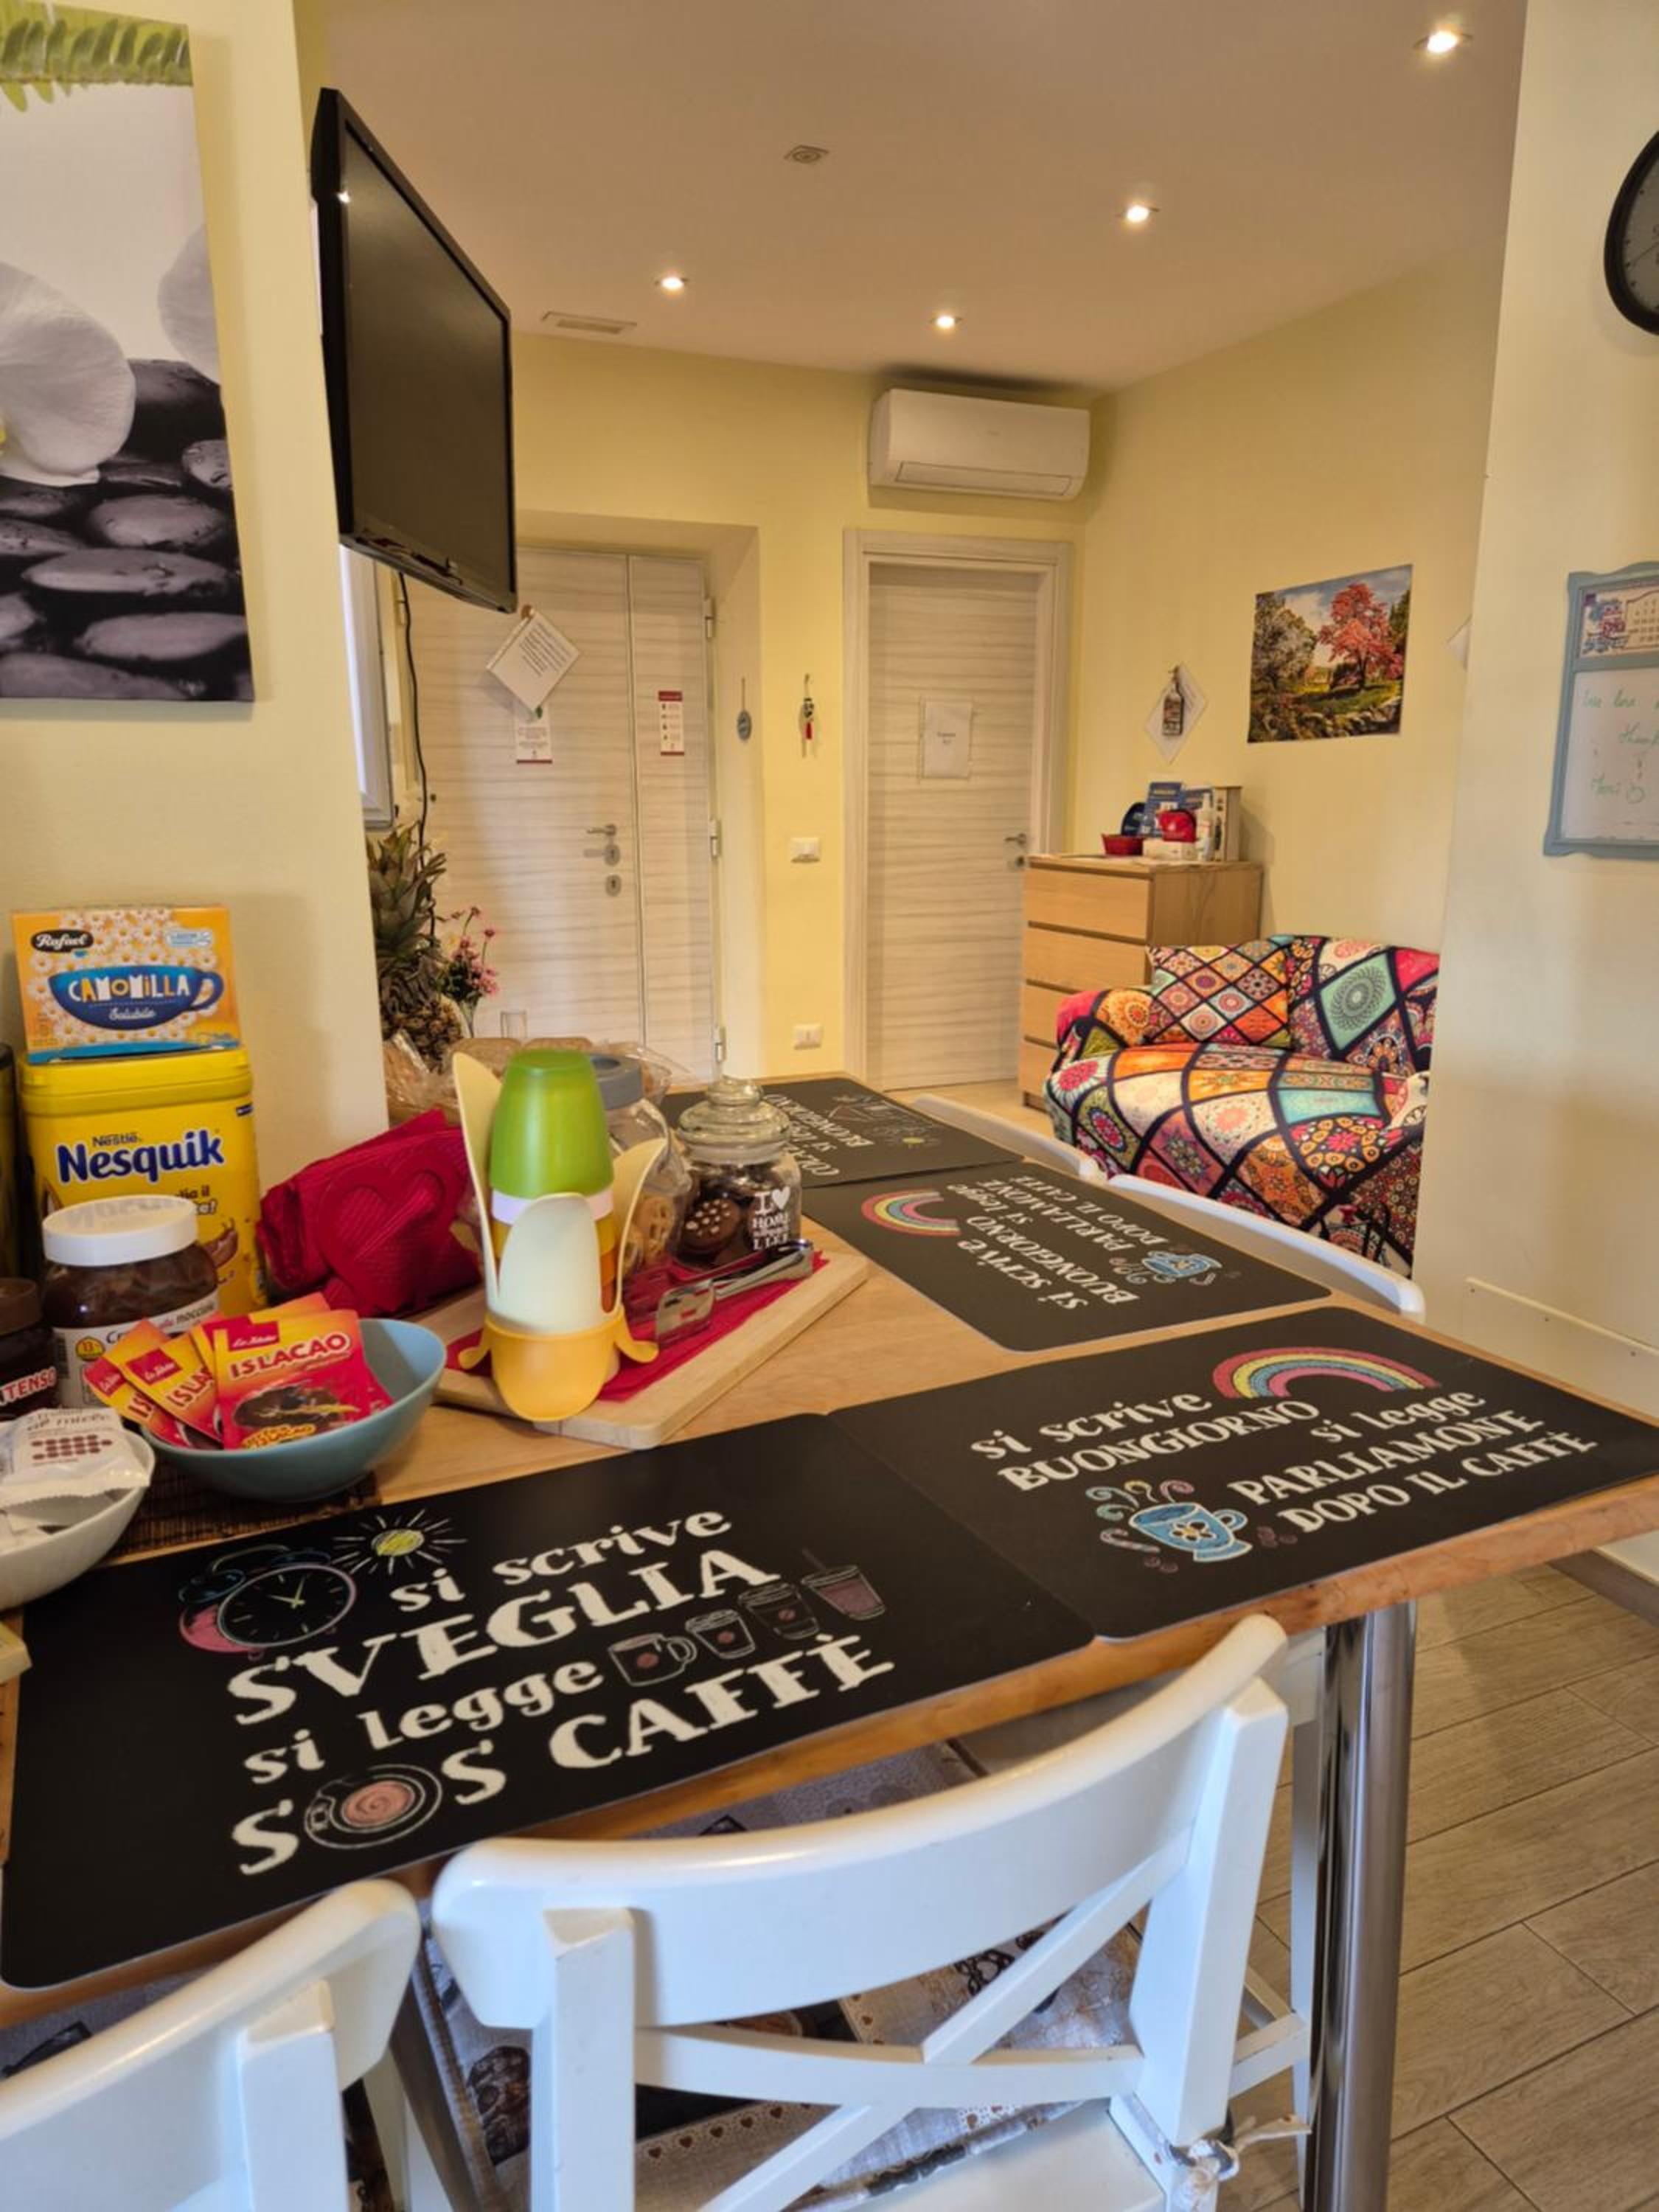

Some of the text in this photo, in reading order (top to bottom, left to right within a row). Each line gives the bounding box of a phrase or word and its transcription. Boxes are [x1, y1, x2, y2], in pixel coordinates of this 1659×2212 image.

[57, 1129, 224, 1183] Nesquik
[976, 1179, 1135, 1251] PARLIAMONE
[999, 1212, 1034, 1225] si
[1075, 1201, 1105, 1214] IL
[1098, 1214, 1169, 1245] DOPO
[957, 1239, 1088, 1310] si scrive
[967, 1216, 1140, 1304] BUONGIORNO
[1, 1366, 57, 1403] TENSO
[165, 1367, 214, 1408] ISLA
[229, 1333, 347, 1379] ISLACAO
[970, 1393, 1212, 1460] si scrive
[997, 1400, 1321, 1491] BUONGIORNO
[1310, 1391, 1486, 1444] si legge
[1227, 1410, 1545, 1506] PARLIAMONE
[1277, 1431, 1598, 1534] DOPO IL CAFFÈ
[389, 1511, 732, 1612] si scrive
[227, 1549, 781, 1725] SVEGLIA
[243, 1661, 604, 1784] si legge
[549, 1634, 894, 1769] CAFFÈ
